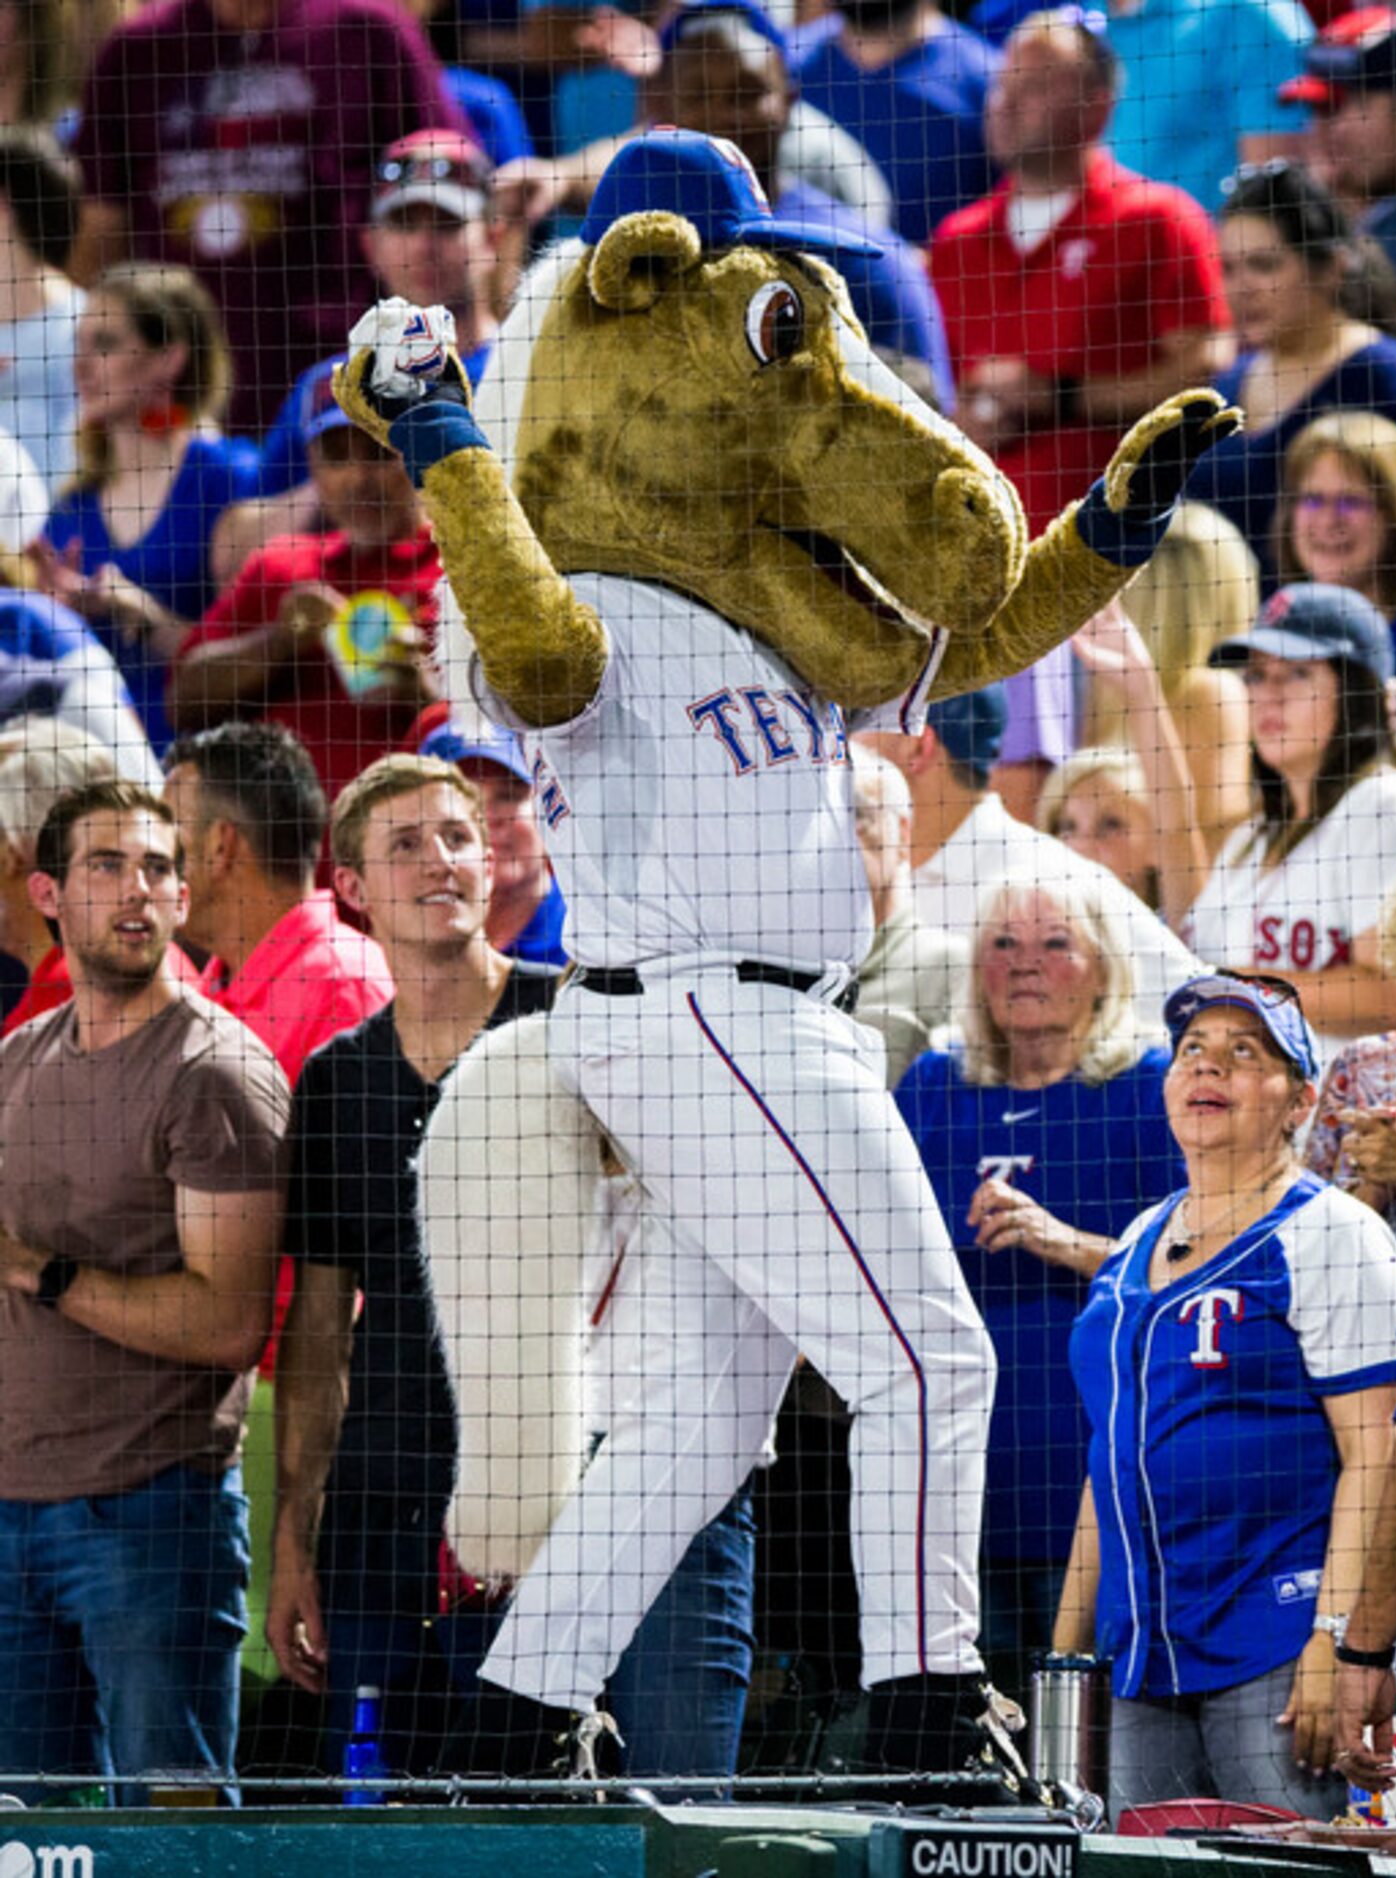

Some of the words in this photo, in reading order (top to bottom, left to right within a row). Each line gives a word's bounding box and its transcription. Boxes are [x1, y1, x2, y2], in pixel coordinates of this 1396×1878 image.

[1256, 916, 1352, 969] SOX
[1178, 1288, 1245, 1370] T
[912, 1839, 1072, 1878] CAUTION!
